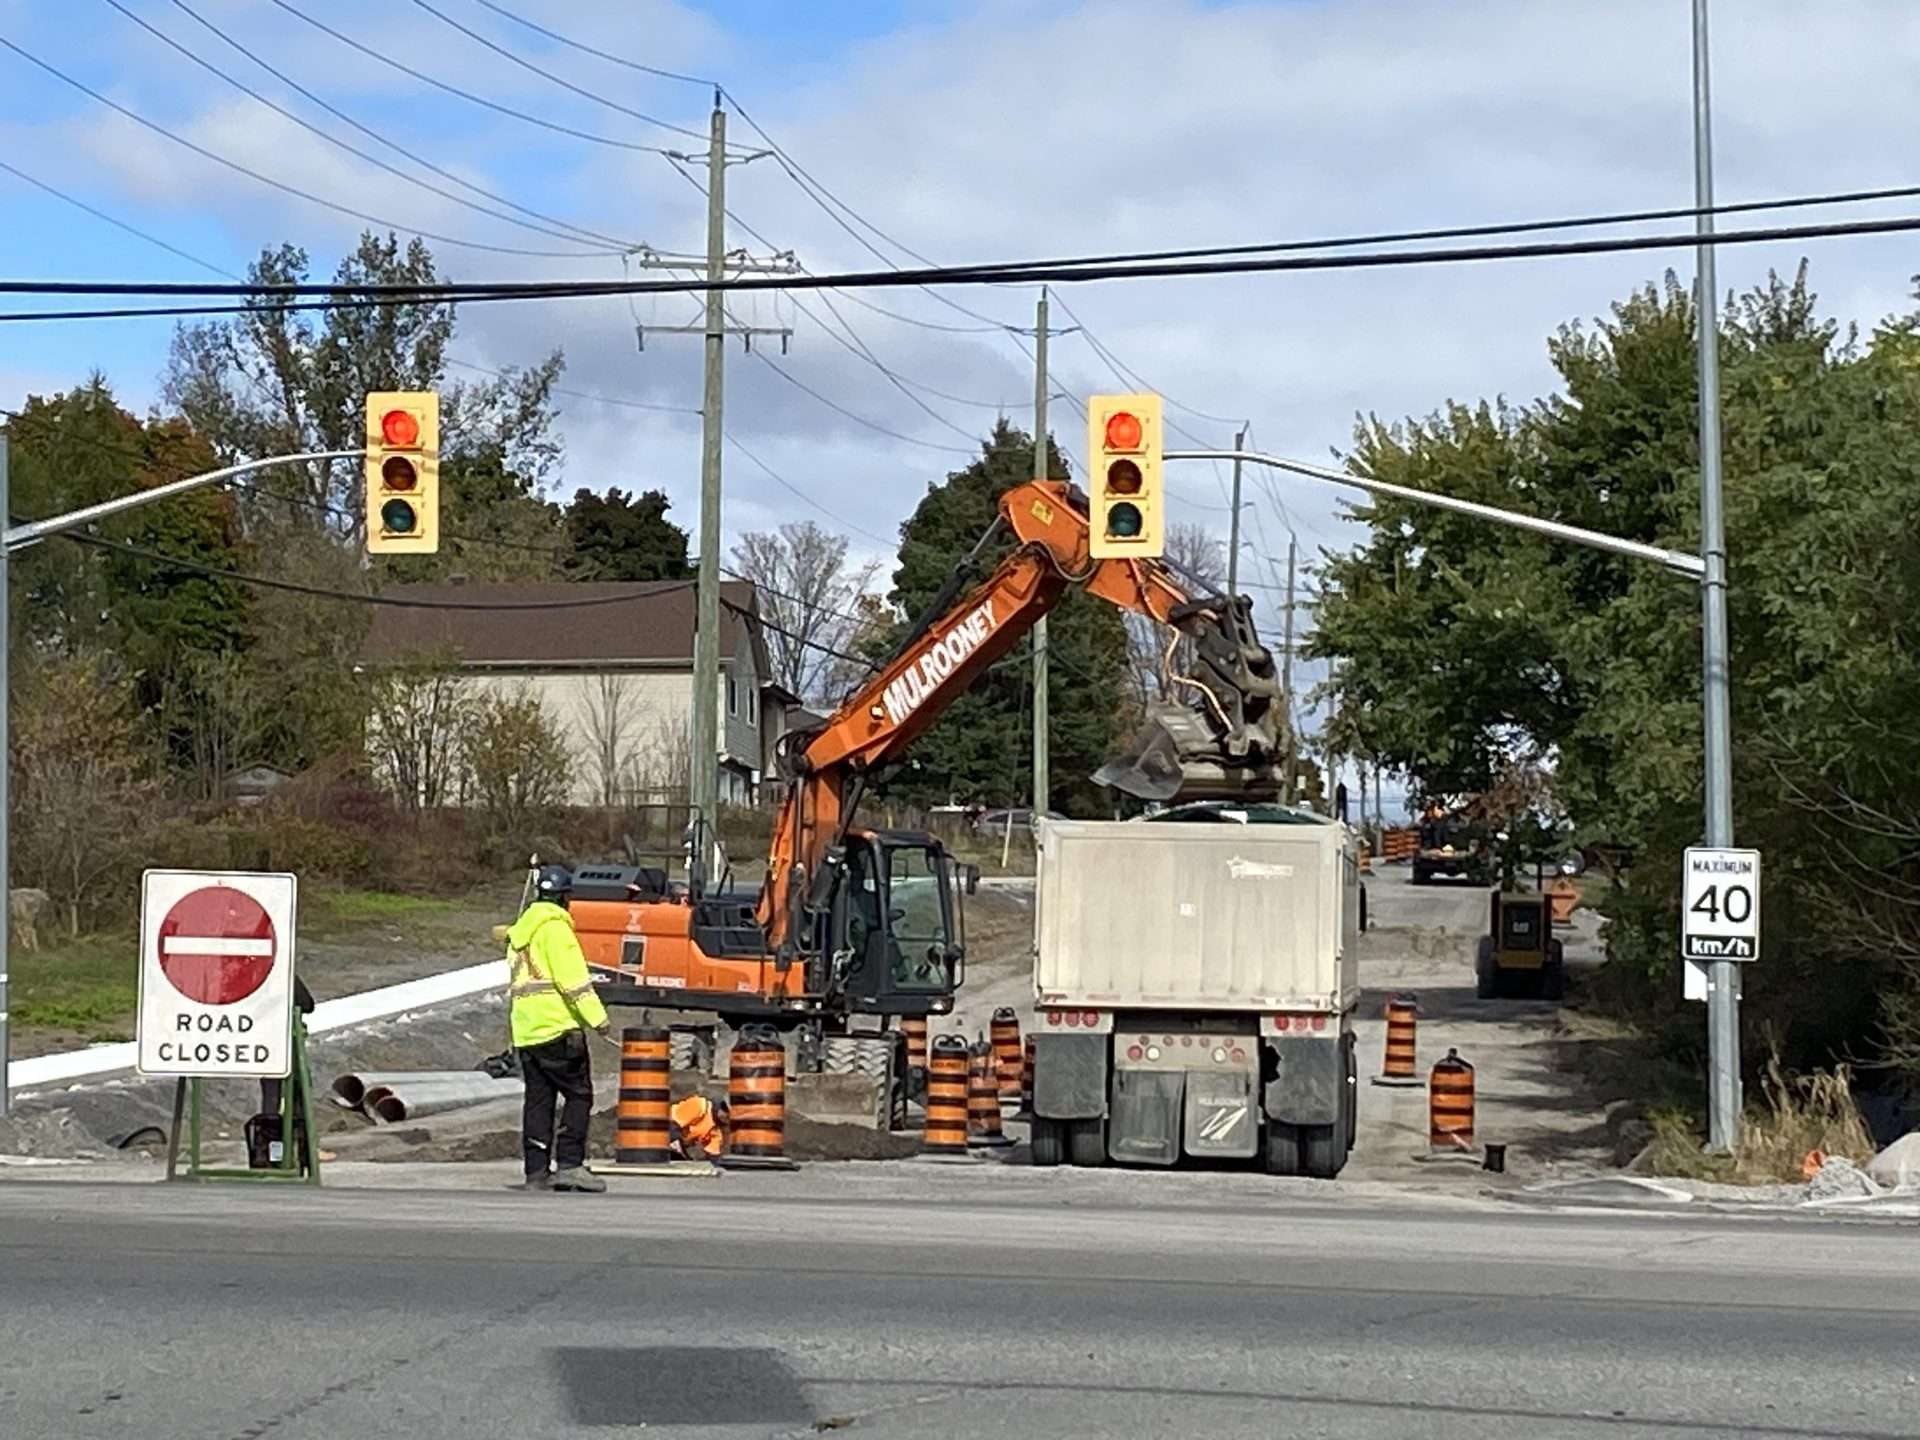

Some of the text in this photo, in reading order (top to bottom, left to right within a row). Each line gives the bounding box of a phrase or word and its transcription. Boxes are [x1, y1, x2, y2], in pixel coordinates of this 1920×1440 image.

[882, 599, 998, 726] MULROONEY
[1693, 860, 1752, 874] MAXIMUM
[1690, 884, 1752, 923] 40
[1691, 937, 1750, 956] km/h
[176, 1013, 254, 1033] ROAD
[158, 1042, 270, 1064] CLOSED
